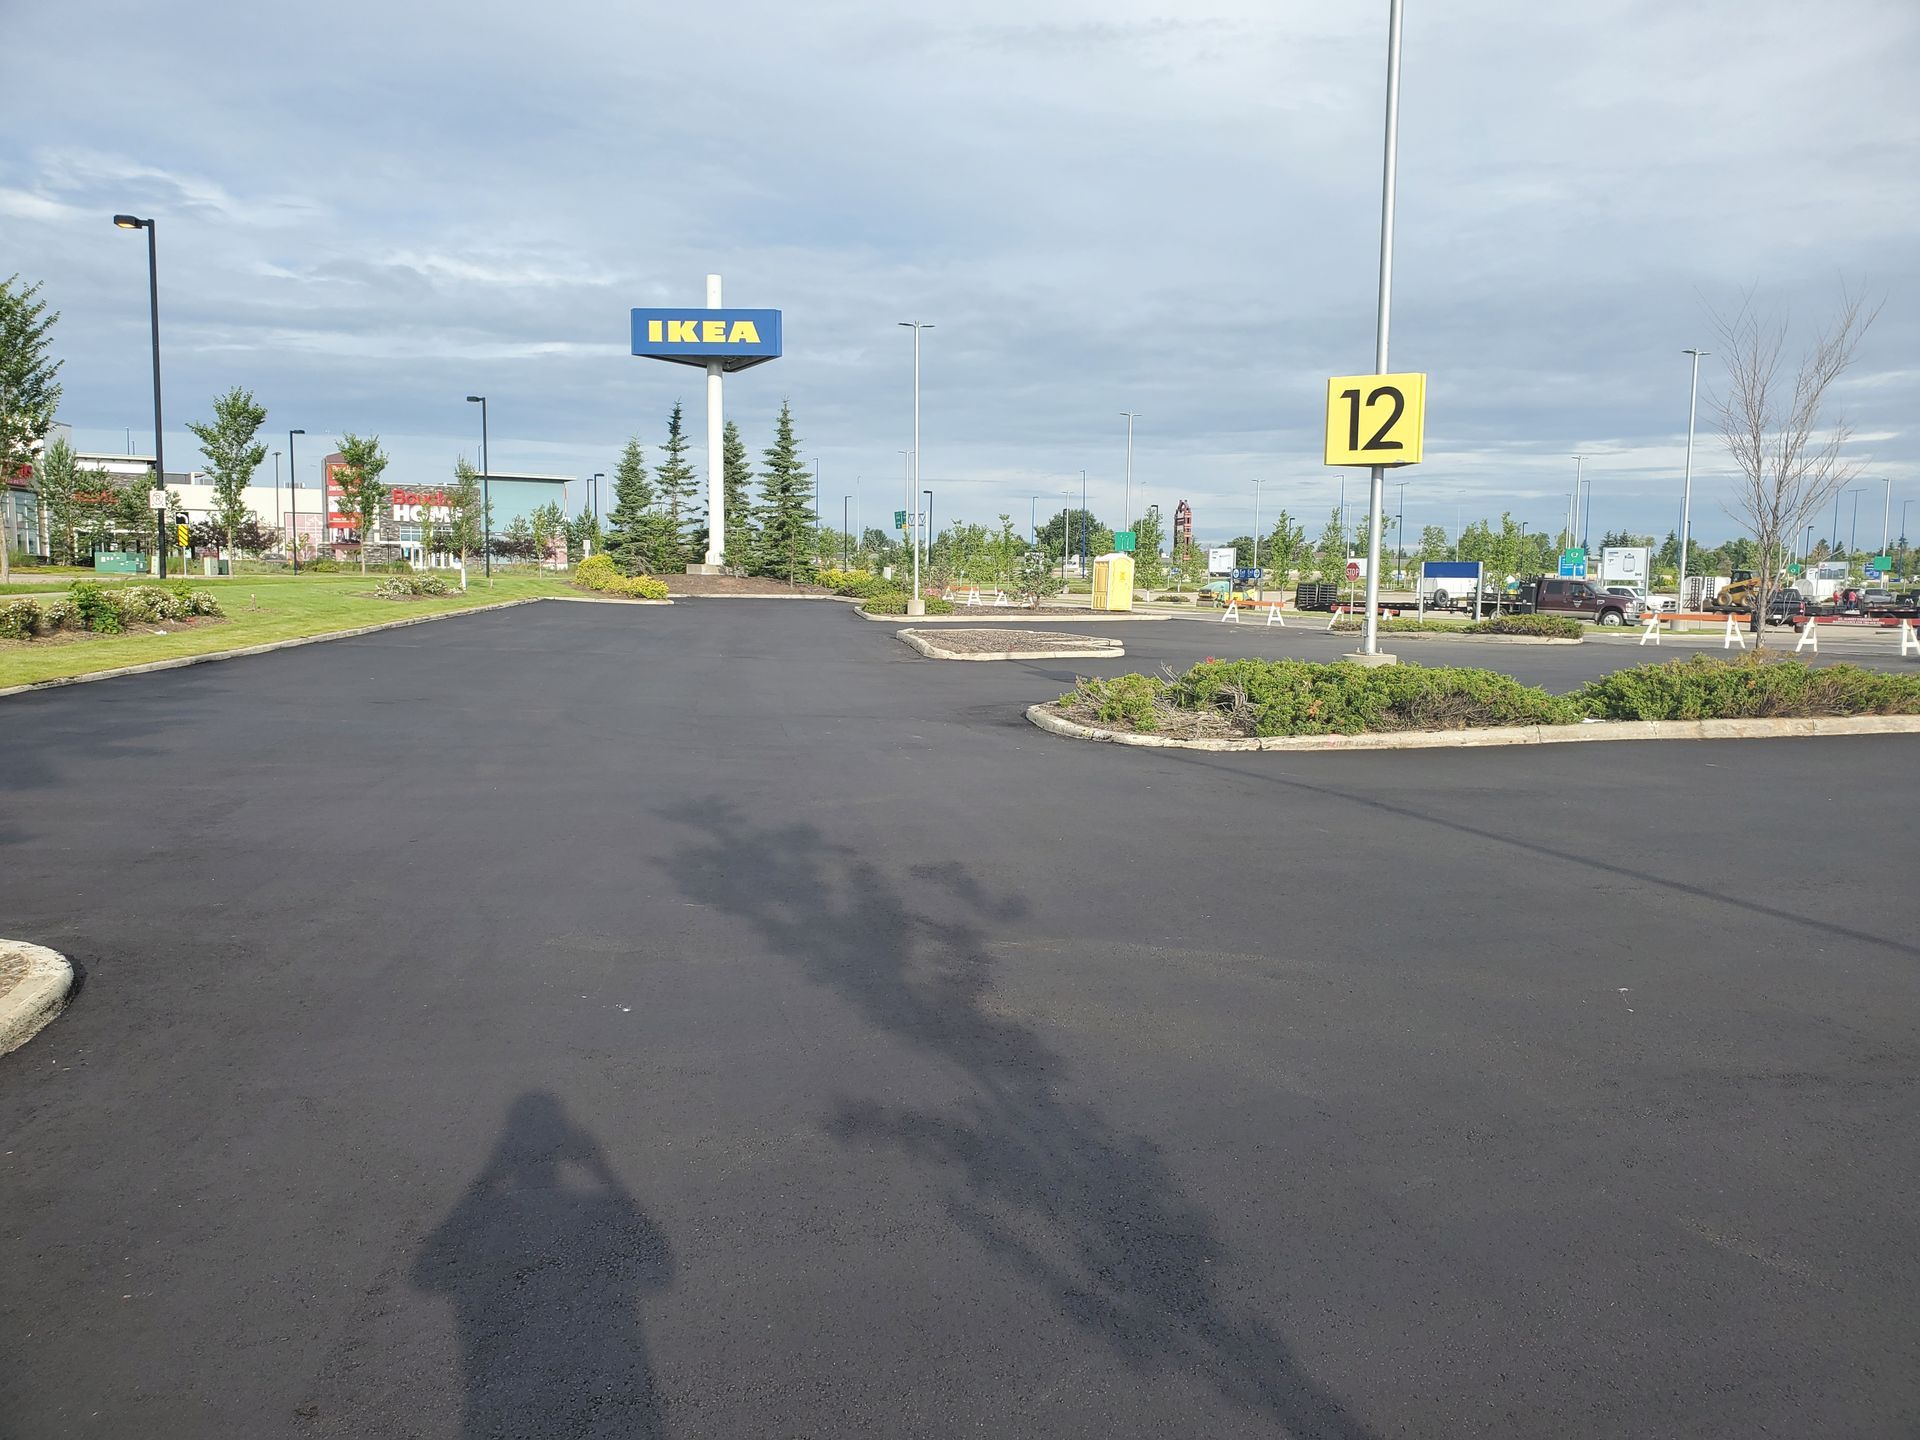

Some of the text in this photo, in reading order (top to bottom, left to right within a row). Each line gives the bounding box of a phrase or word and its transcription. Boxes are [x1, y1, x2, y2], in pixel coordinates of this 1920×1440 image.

[648, 320, 761, 343] IKEA
[1340, 386, 1404, 451] 12
[393, 504, 463, 523] HOME
[1346, 567, 1360, 577] STOP
